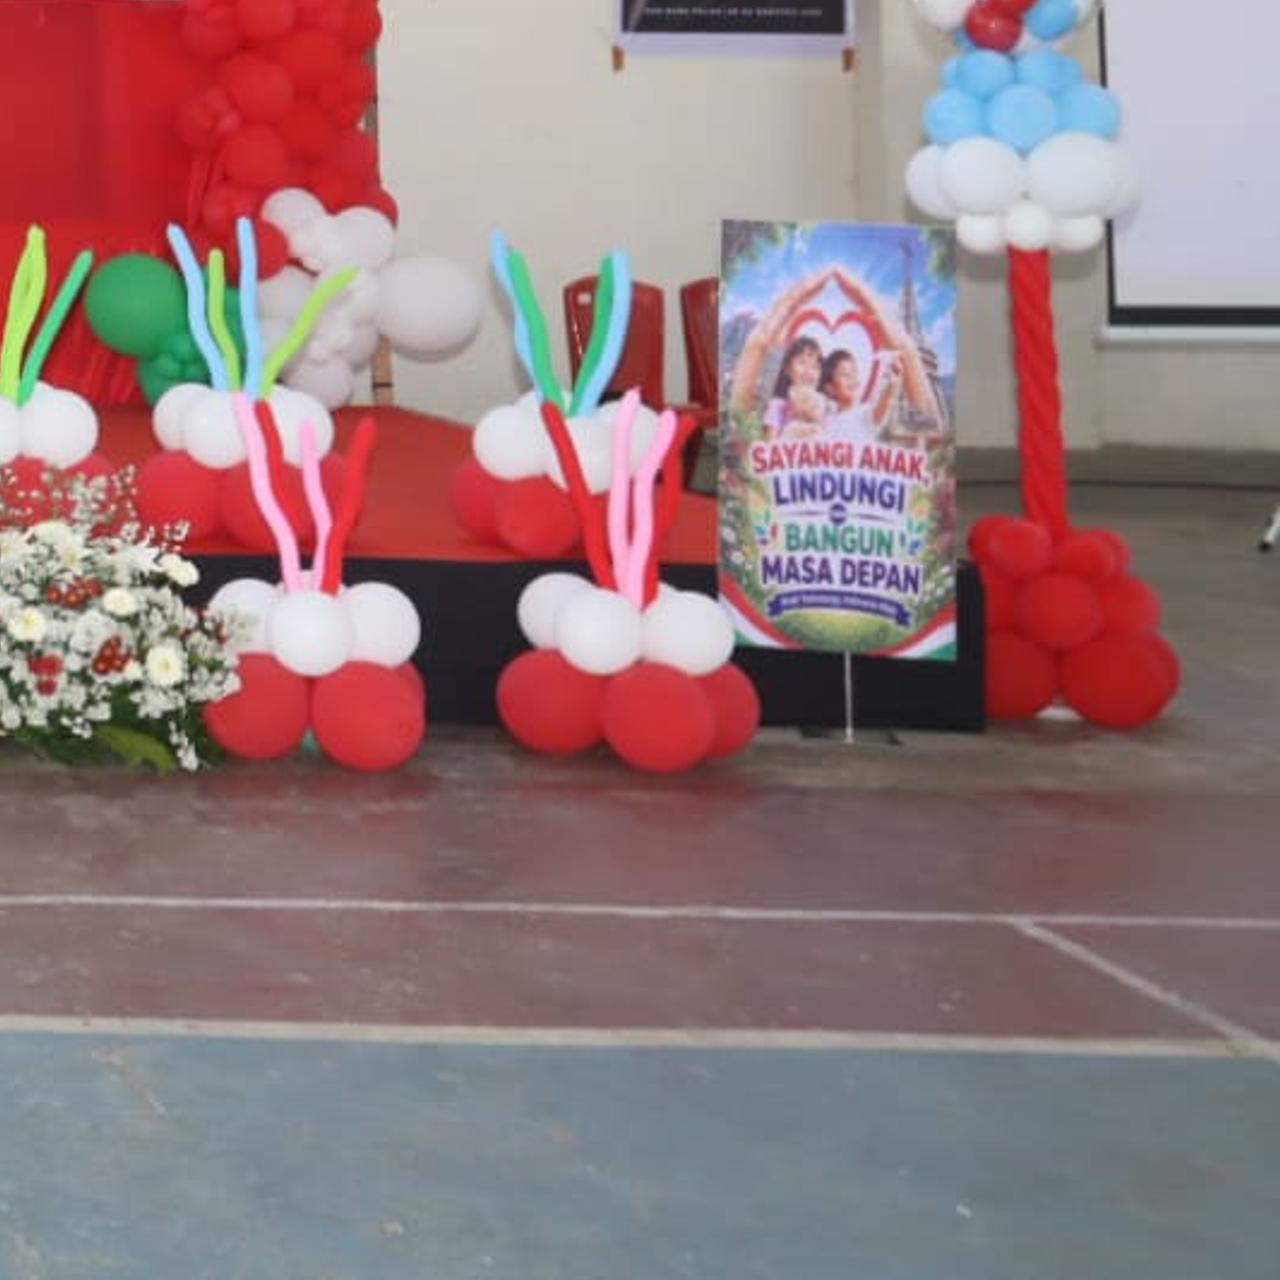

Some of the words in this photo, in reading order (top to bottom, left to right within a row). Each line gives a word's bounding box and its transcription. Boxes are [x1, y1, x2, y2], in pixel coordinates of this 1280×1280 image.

[752, 443, 853, 475] SAYANGI
[859, 447, 930, 486] ANAK,
[773, 473, 906, 513] LINDUNGI
[784, 523, 895, 557] BANGUN
[761, 556, 834, 585] MASA
[840, 557, 921, 594] DEPAN
